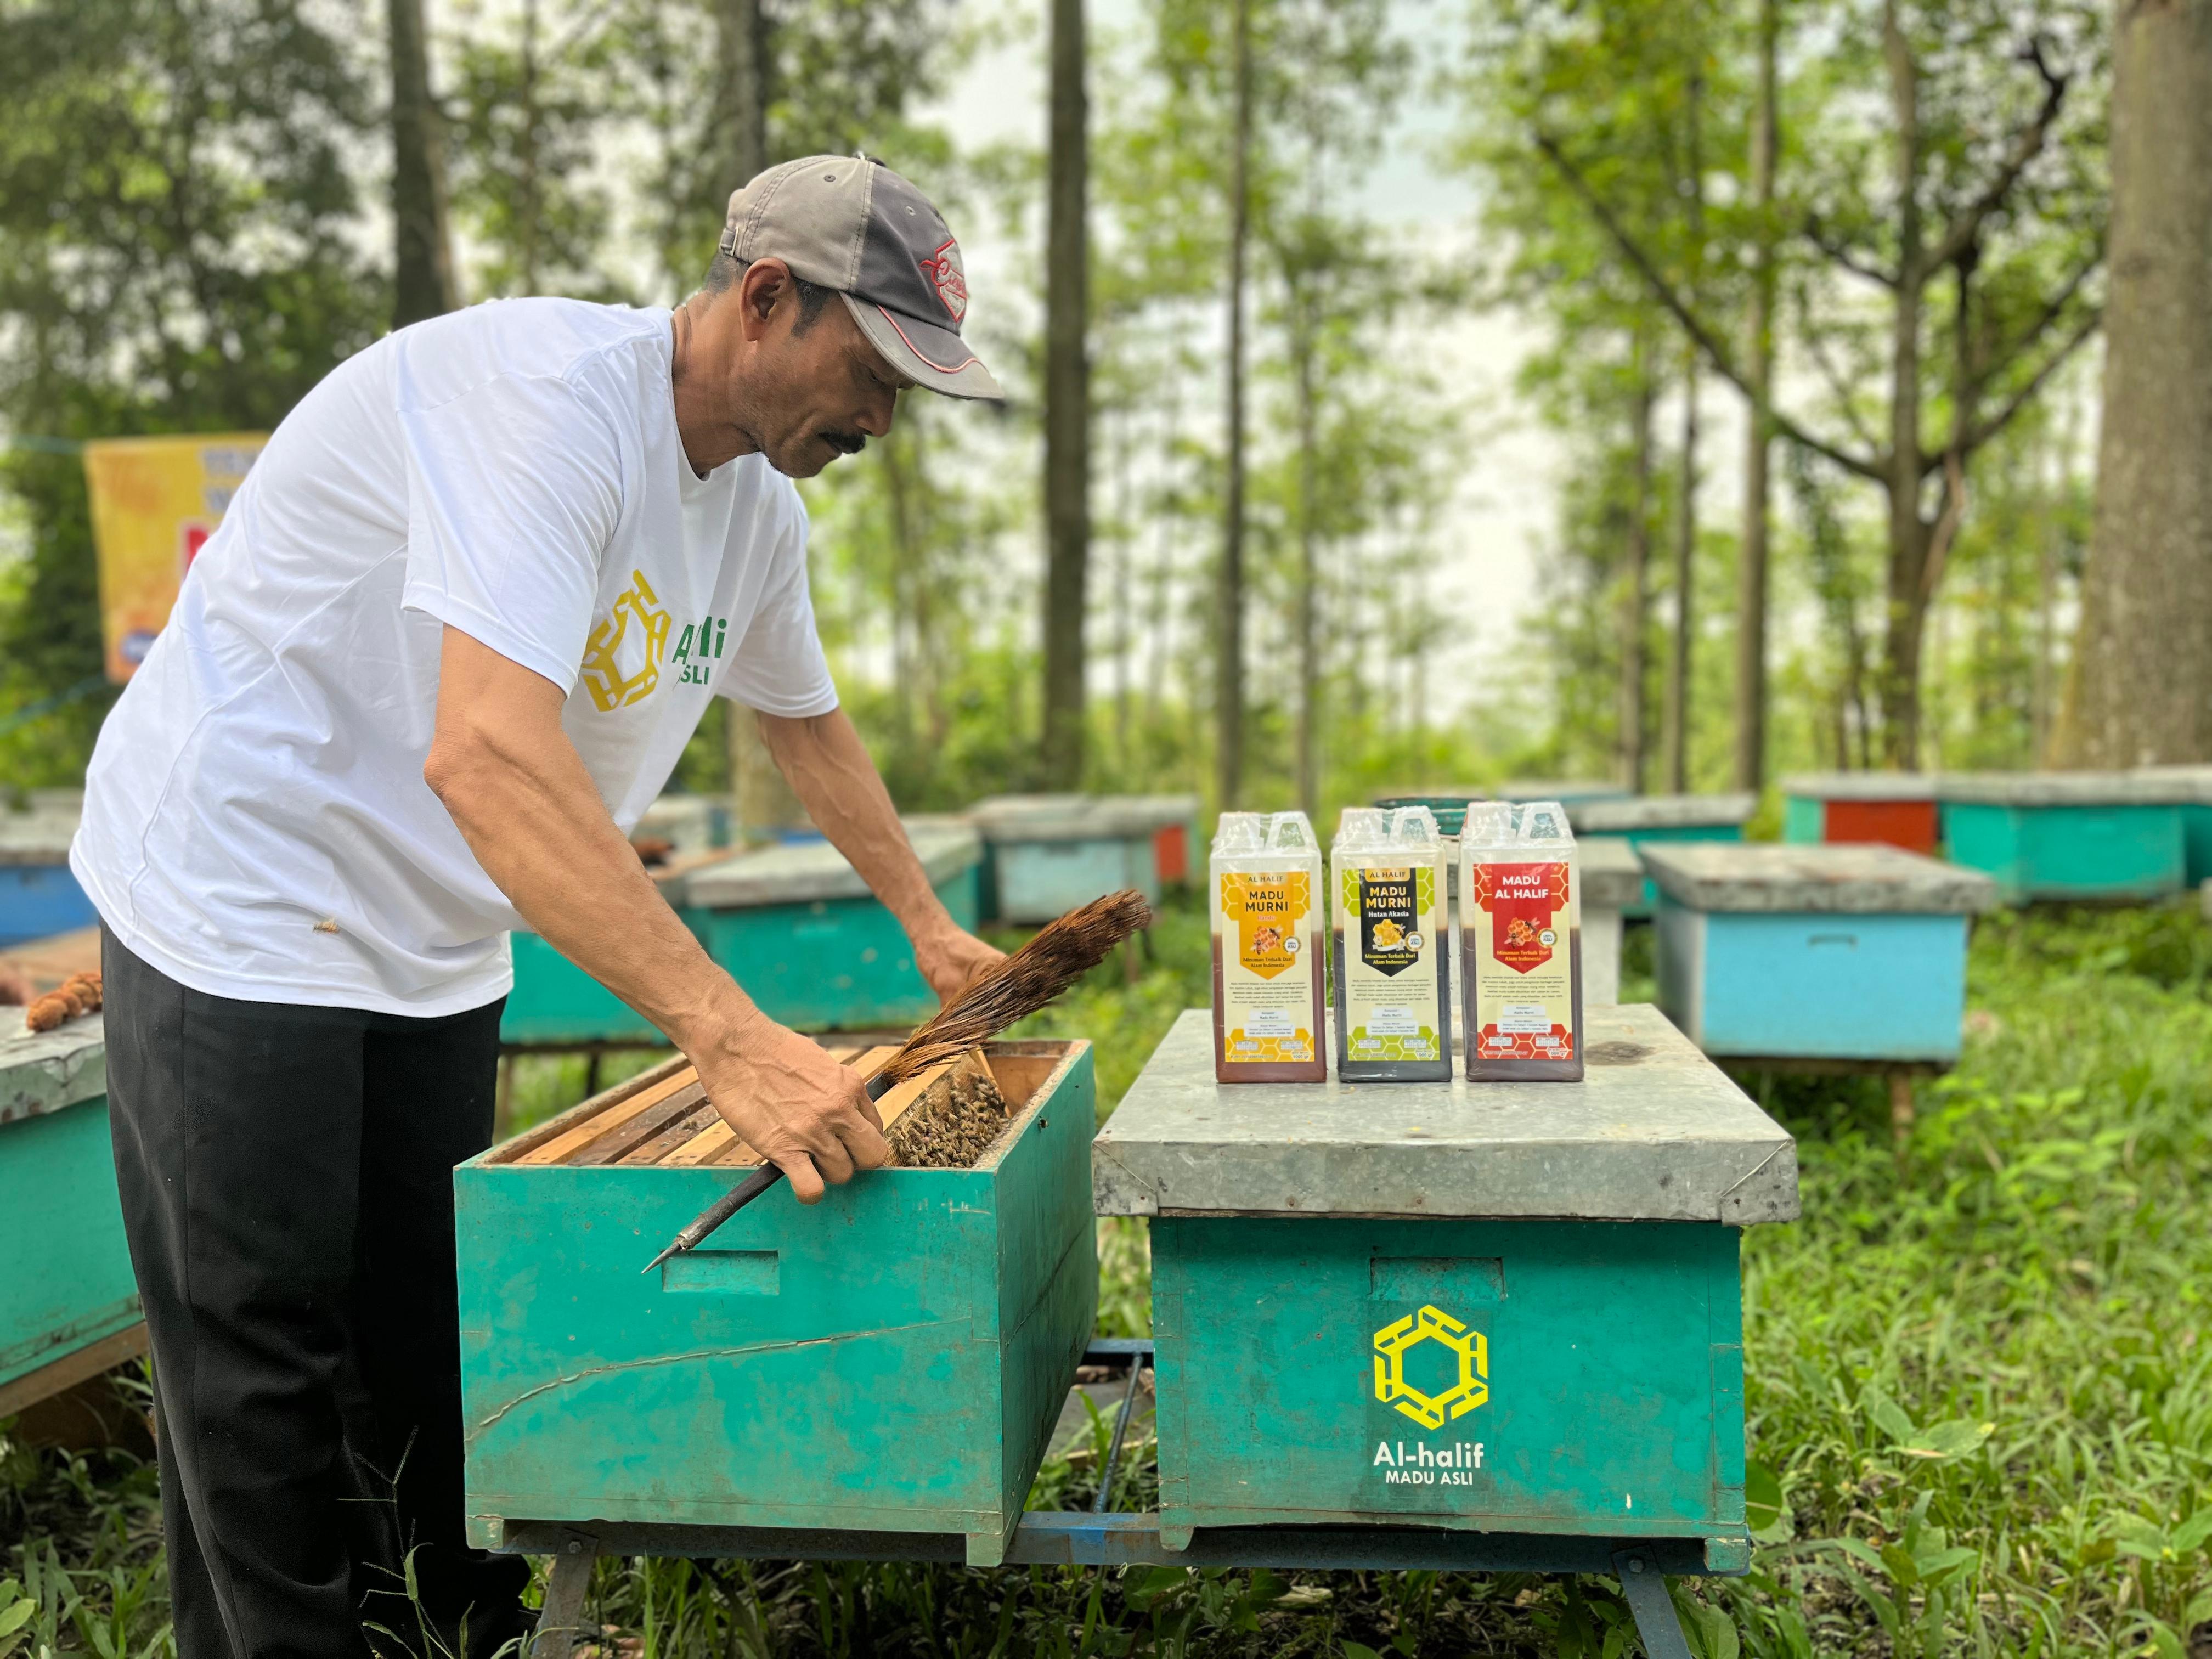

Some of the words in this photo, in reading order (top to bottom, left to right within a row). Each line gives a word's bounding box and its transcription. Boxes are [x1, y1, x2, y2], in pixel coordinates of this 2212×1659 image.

[680, 664, 709, 685] SLI
[1502, 876, 1540, 885] MADU
[1249, 891, 1284, 900] MADU
[1370, 887, 1406, 896] MADU
[1494, 889, 1510, 899] AL
[1514, 889, 1548, 899] HALIF
[1245, 901, 1288, 912] MURNI
[1366, 897, 1410, 909] MURNI
[1373, 1441, 1484, 1468] Al-halif
[1386, 1470, 1434, 1485] MADU
[1440, 1472, 1472, 1485] ASLI
